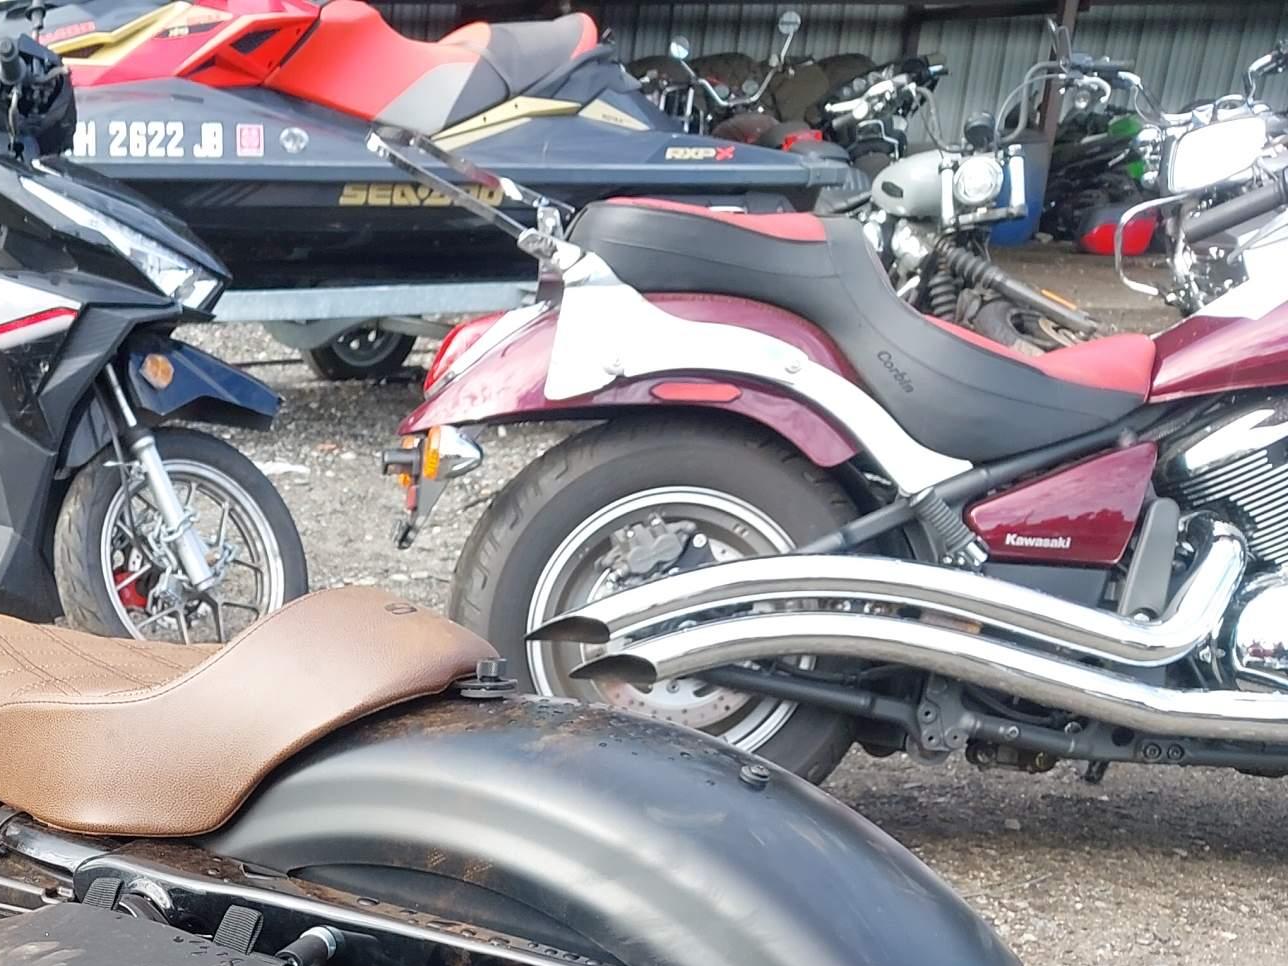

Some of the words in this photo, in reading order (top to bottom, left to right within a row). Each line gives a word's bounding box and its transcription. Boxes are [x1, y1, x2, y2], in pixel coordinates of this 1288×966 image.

[109, 121, 184, 157] 2622
[877, 350, 914, 393] Corbin
[1005, 533, 1071, 549] Kawasaki
